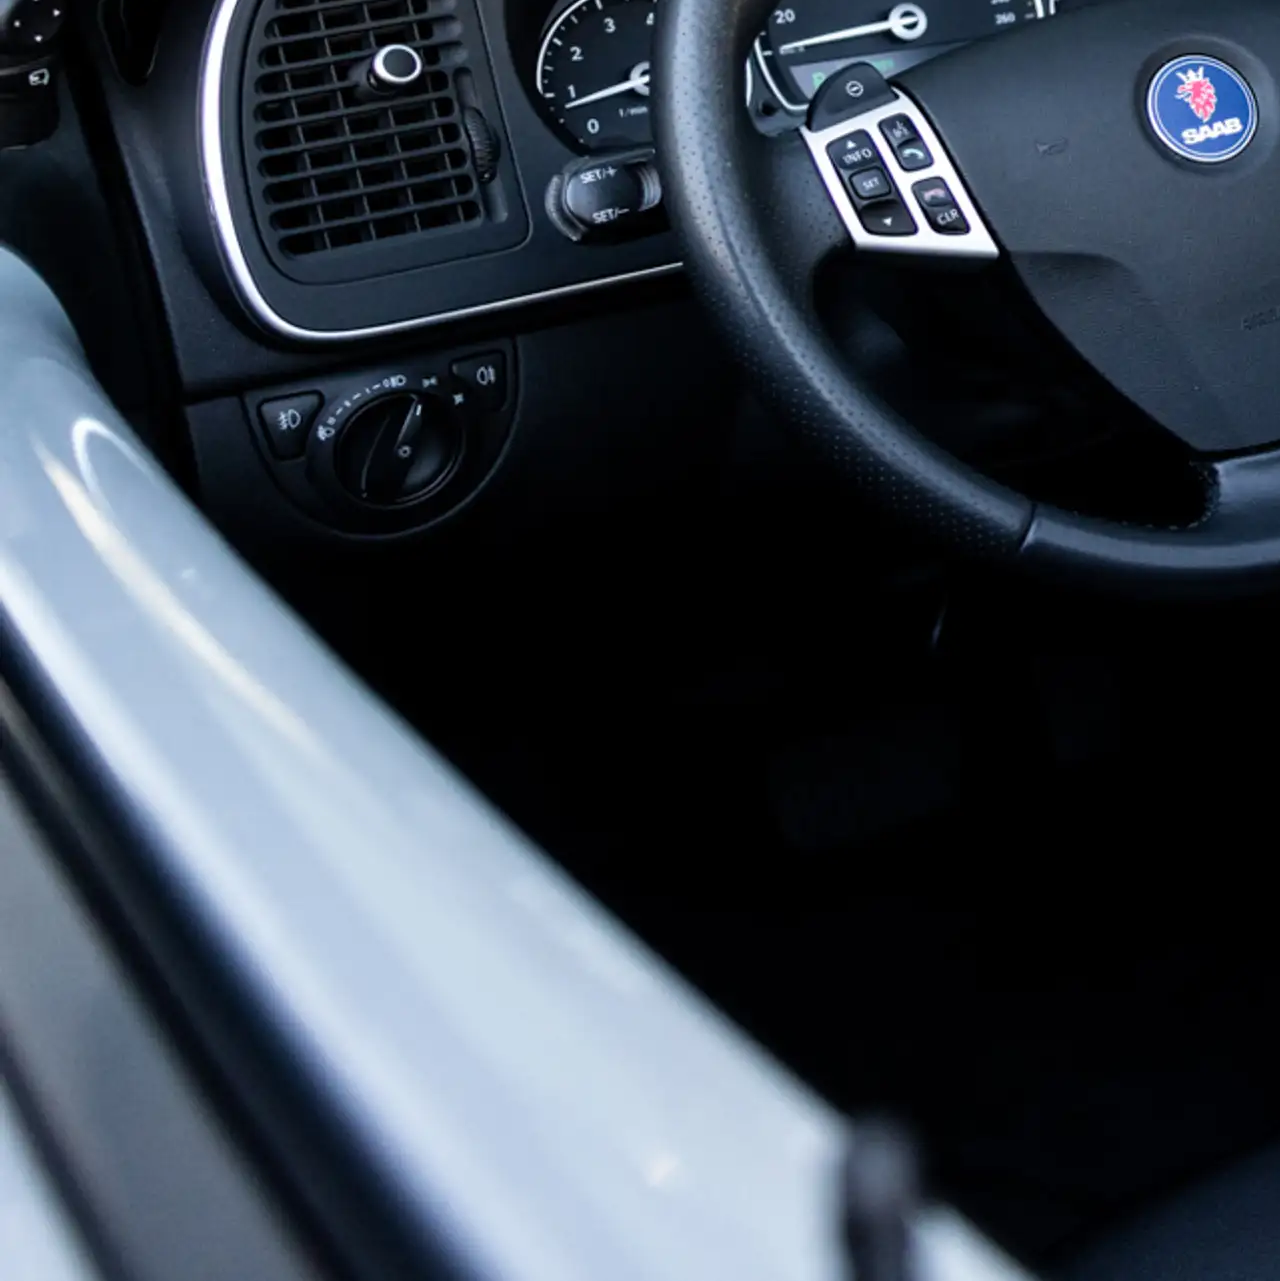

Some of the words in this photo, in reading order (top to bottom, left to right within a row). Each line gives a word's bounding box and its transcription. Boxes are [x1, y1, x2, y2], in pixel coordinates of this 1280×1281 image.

[774, 8, 795, 24] 20
[603, 17, 616, 33] 3
[570, 46, 584, 61] 2
[567, 84, 576, 98] 1
[586, 118, 600, 134] 0
[1181, 117, 1243, 145] SAAB
[842, 148, 872, 164] INFO
[580, 166, 617, 184] SET/+
[862, 178, 879, 190] SET
[936, 209, 960, 225] CLR
